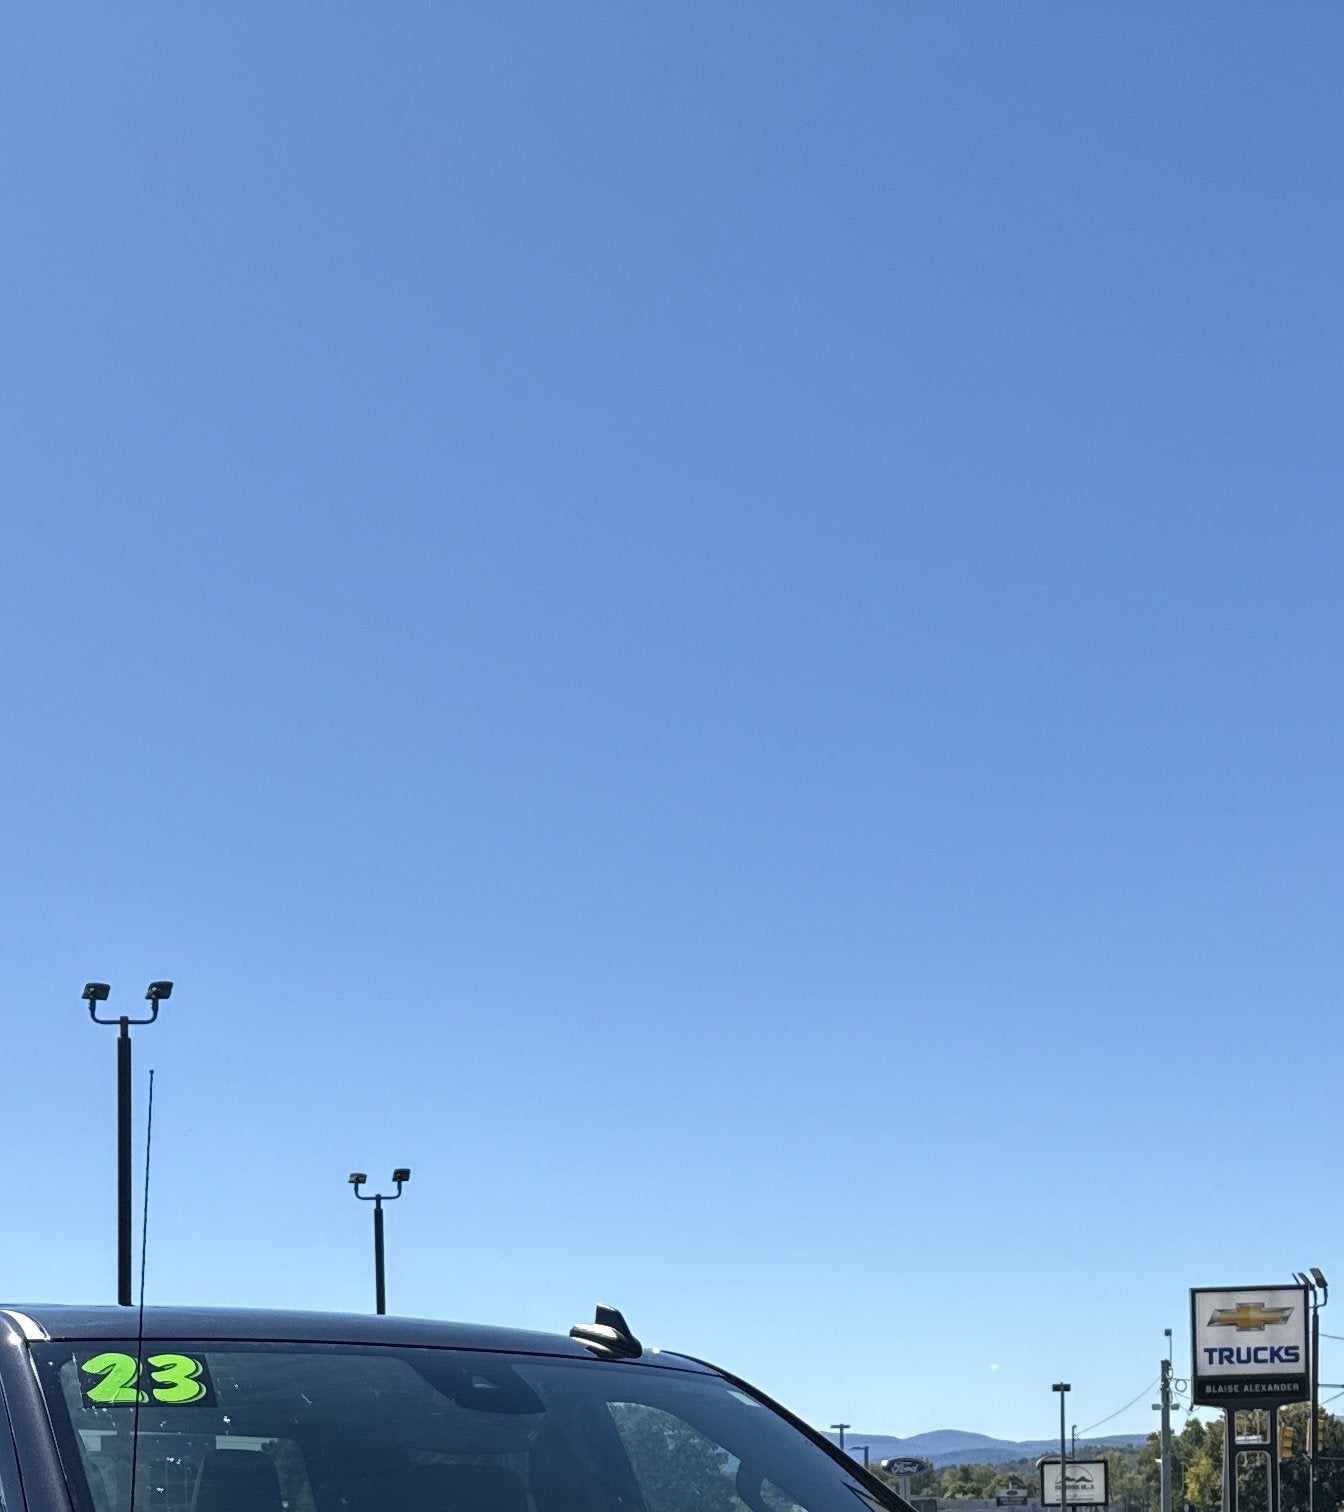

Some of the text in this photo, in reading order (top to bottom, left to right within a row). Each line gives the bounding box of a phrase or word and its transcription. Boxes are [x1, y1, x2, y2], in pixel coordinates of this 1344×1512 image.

[1203, 1345, 1300, 1365] TRUCKS
[81, 1352, 207, 1404] 23
[1205, 1382, 1300, 1393] BLAISE ALEXANDER
[891, 1461, 919, 1474] Ford
